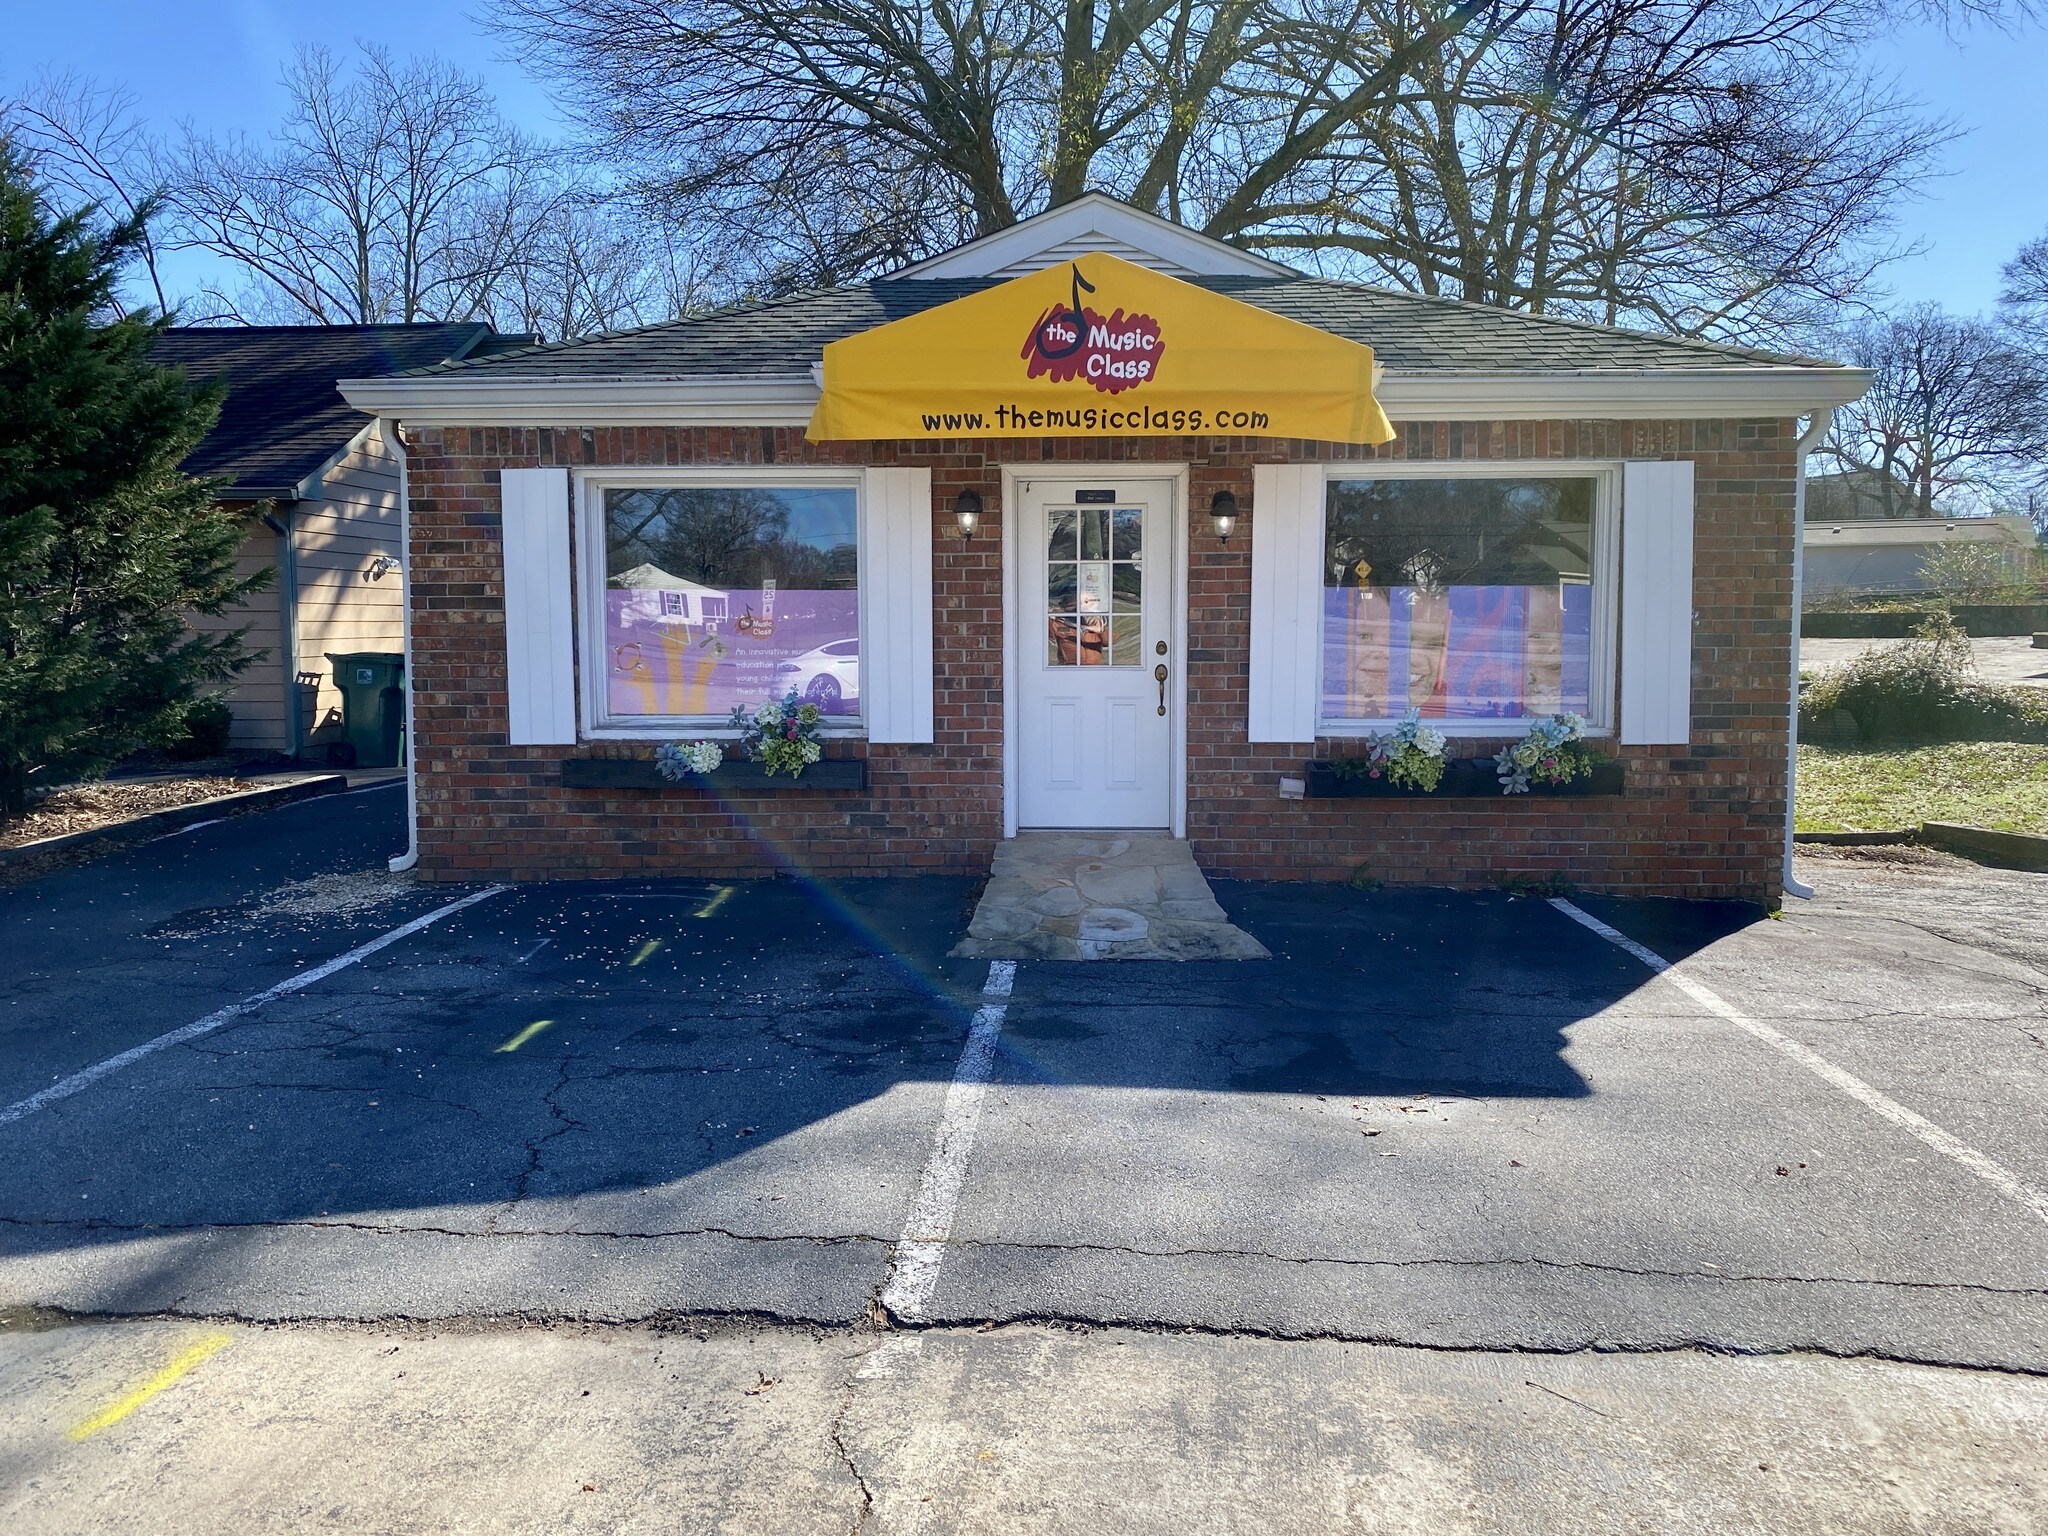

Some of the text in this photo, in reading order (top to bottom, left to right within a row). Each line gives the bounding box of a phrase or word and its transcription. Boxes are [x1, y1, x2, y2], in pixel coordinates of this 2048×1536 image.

[1046, 323, 1156, 351] the Music
[1086, 353, 1151, 379] Class
[921, 404, 1270, 432] www.themusicclass.com
[735, 648, 746, 656] An
[748, 648, 789, 656] innovative
[735, 661, 774, 669] education
[735, 675, 758, 684] young
[735, 687, 756, 695] their
[758, 687, 771, 695] full
